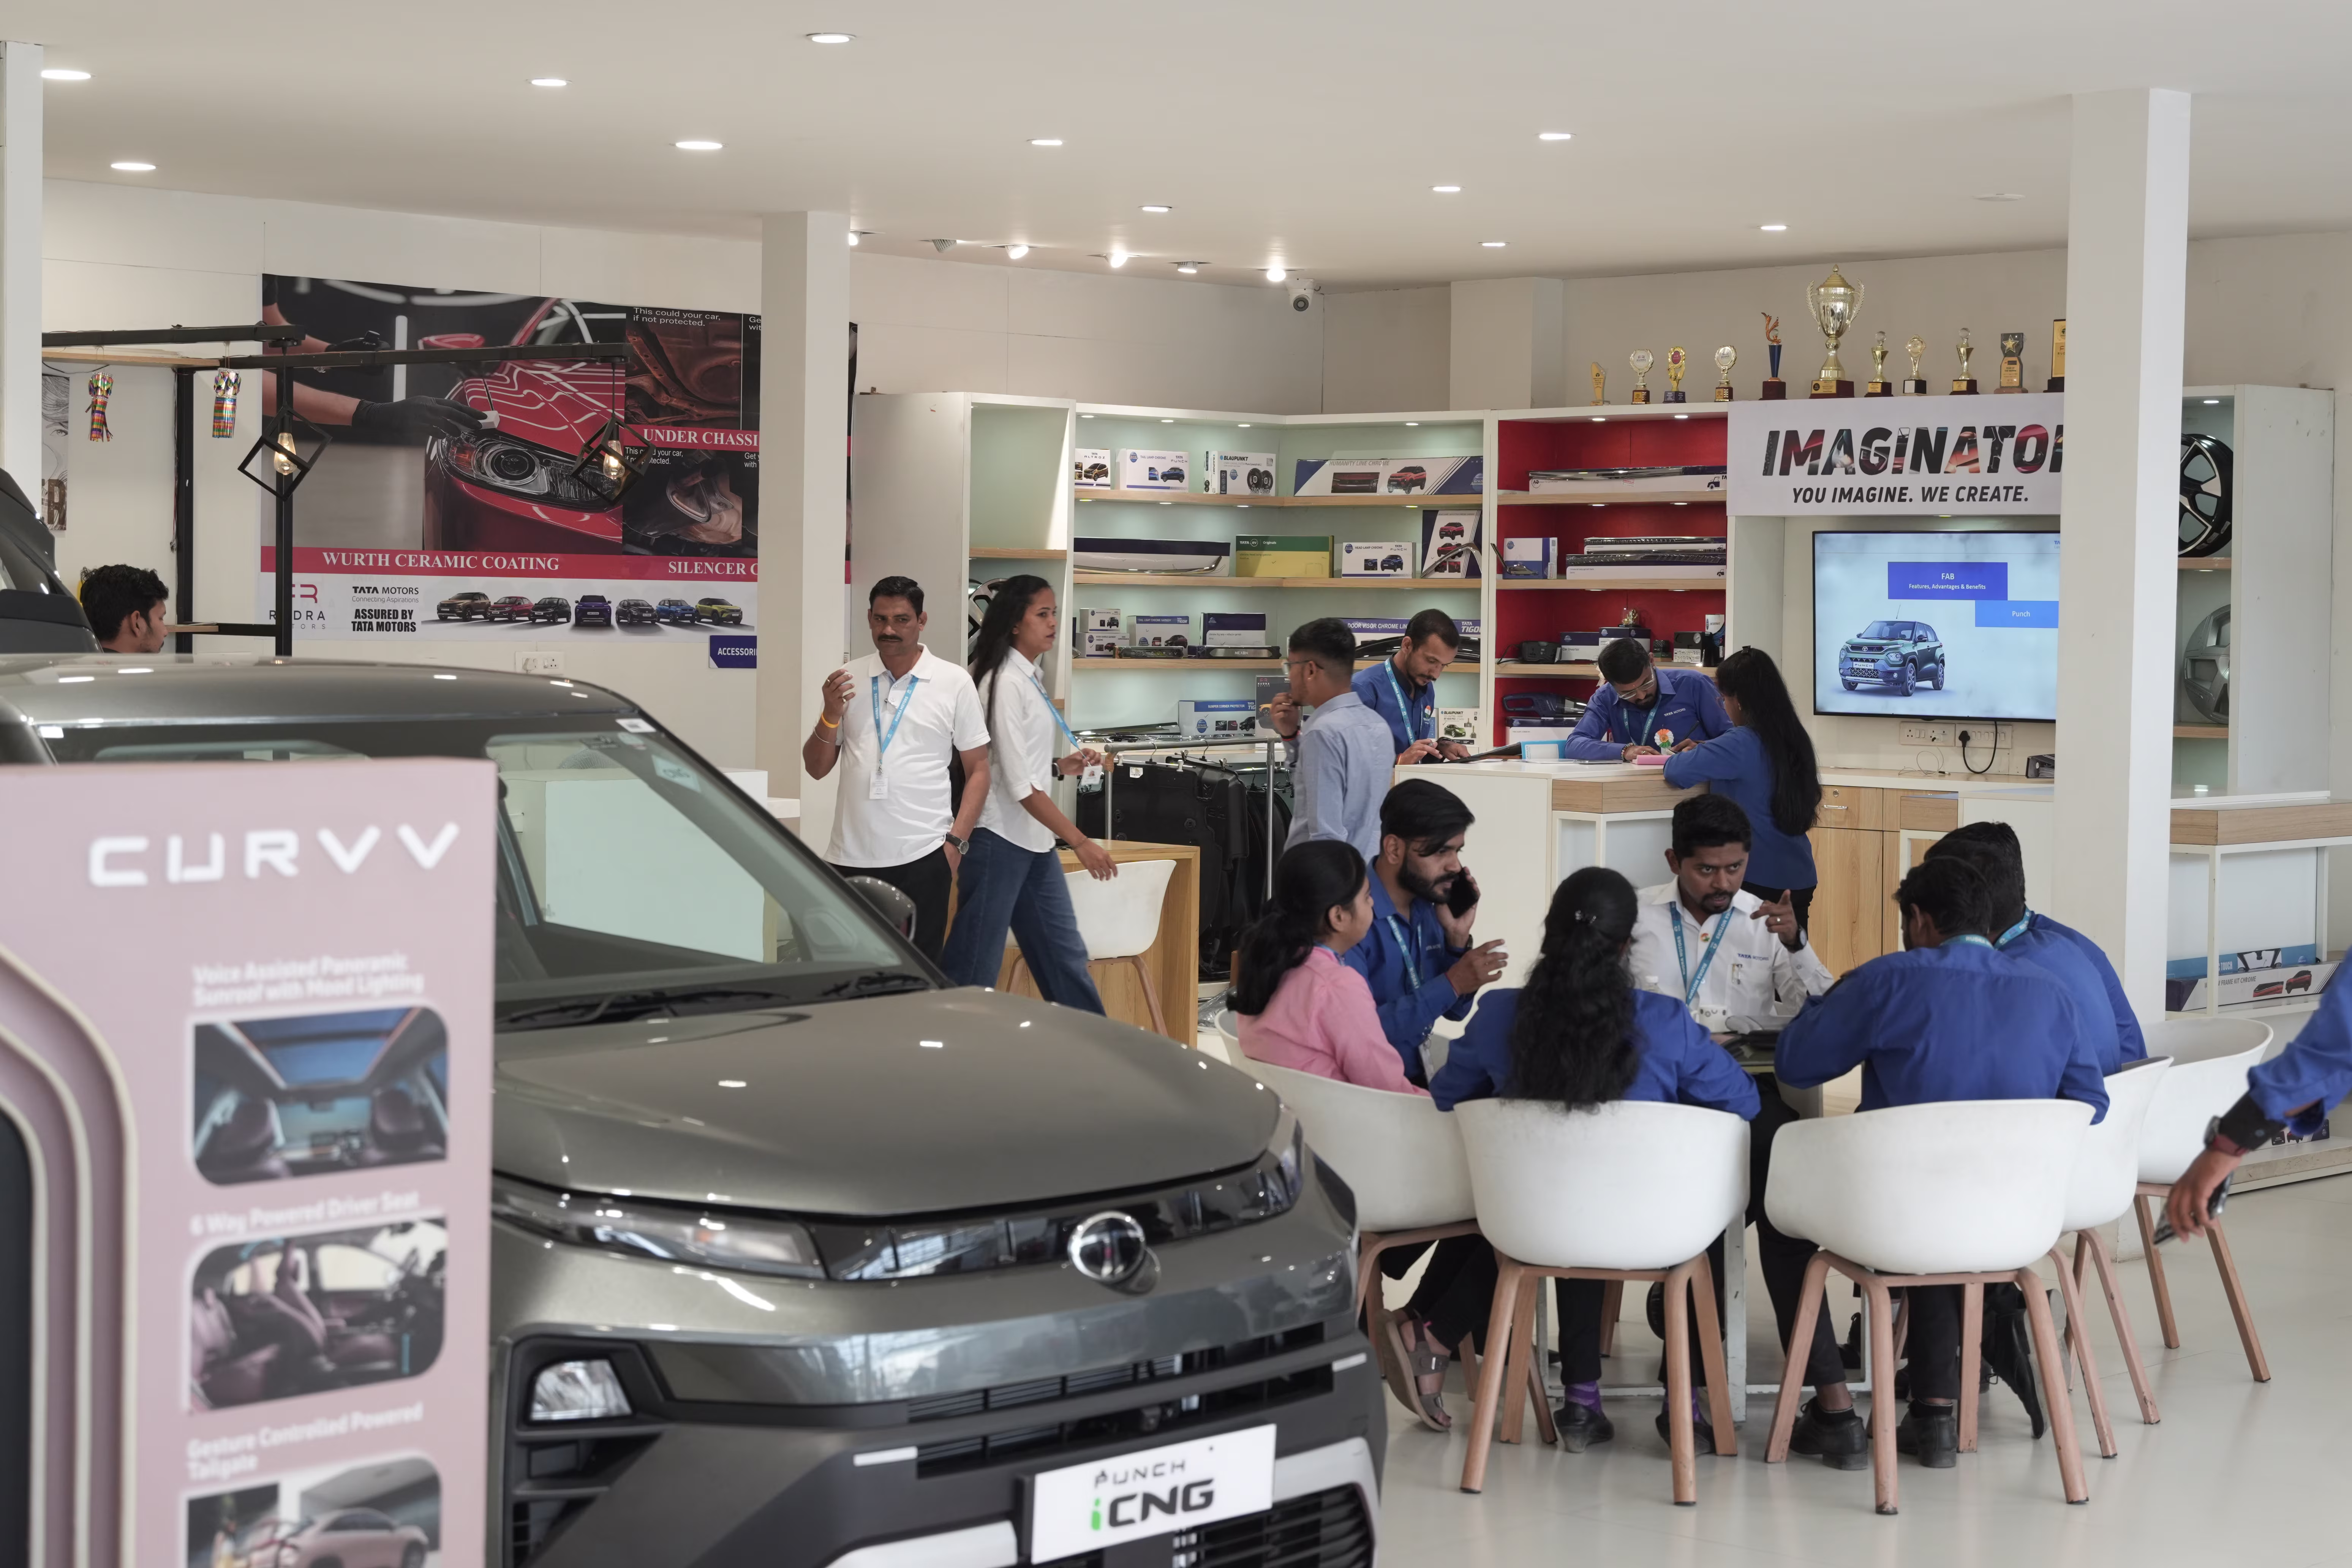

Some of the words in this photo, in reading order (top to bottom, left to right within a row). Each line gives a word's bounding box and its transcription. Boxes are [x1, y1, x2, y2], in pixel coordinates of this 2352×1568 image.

[660, 318, 705, 326] protected.
[644, 429, 698, 443] UNDER
[703, 432, 758, 446] CHASSI
[1793, 487, 1825, 503] YOU
[1832, 487, 1913, 503] IMAGINE.
[1921, 486, 1950, 502] WE
[1955, 485, 2028, 502] CREATE.
[322, 552, 390, 566] WURTH
[395, 554, 477, 569] CERAMIC
[482, 556, 559, 570] COATING
[669, 561, 746, 575] SILENCER
[269, 610, 325, 620] RDRA
[354, 609, 399, 619] ASSURED
[401, 610, 413, 620] BY
[351, 621, 374, 632] TATA
[376, 621, 416, 632] MOTORS
[718, 648, 757, 656] ACCESSORI
[89, 822, 459, 887] CURVV
[1716, 920, 1727, 939] MOTORS
[244, 958, 319, 980] Assisted
[321, 951, 409, 975] Panoramic
[1697, 963, 1707, 979] RUDRA
[2221, 961, 2232, 971] TOUCH
[266, 980, 303, 1001] with
[1688, 978, 1699, 999] MOTORS
[259, 1416, 348, 1446] Controlled
[1095, 1460, 1185, 1488] PUNCH
[1091, 1478, 1214, 1531] iCNG
